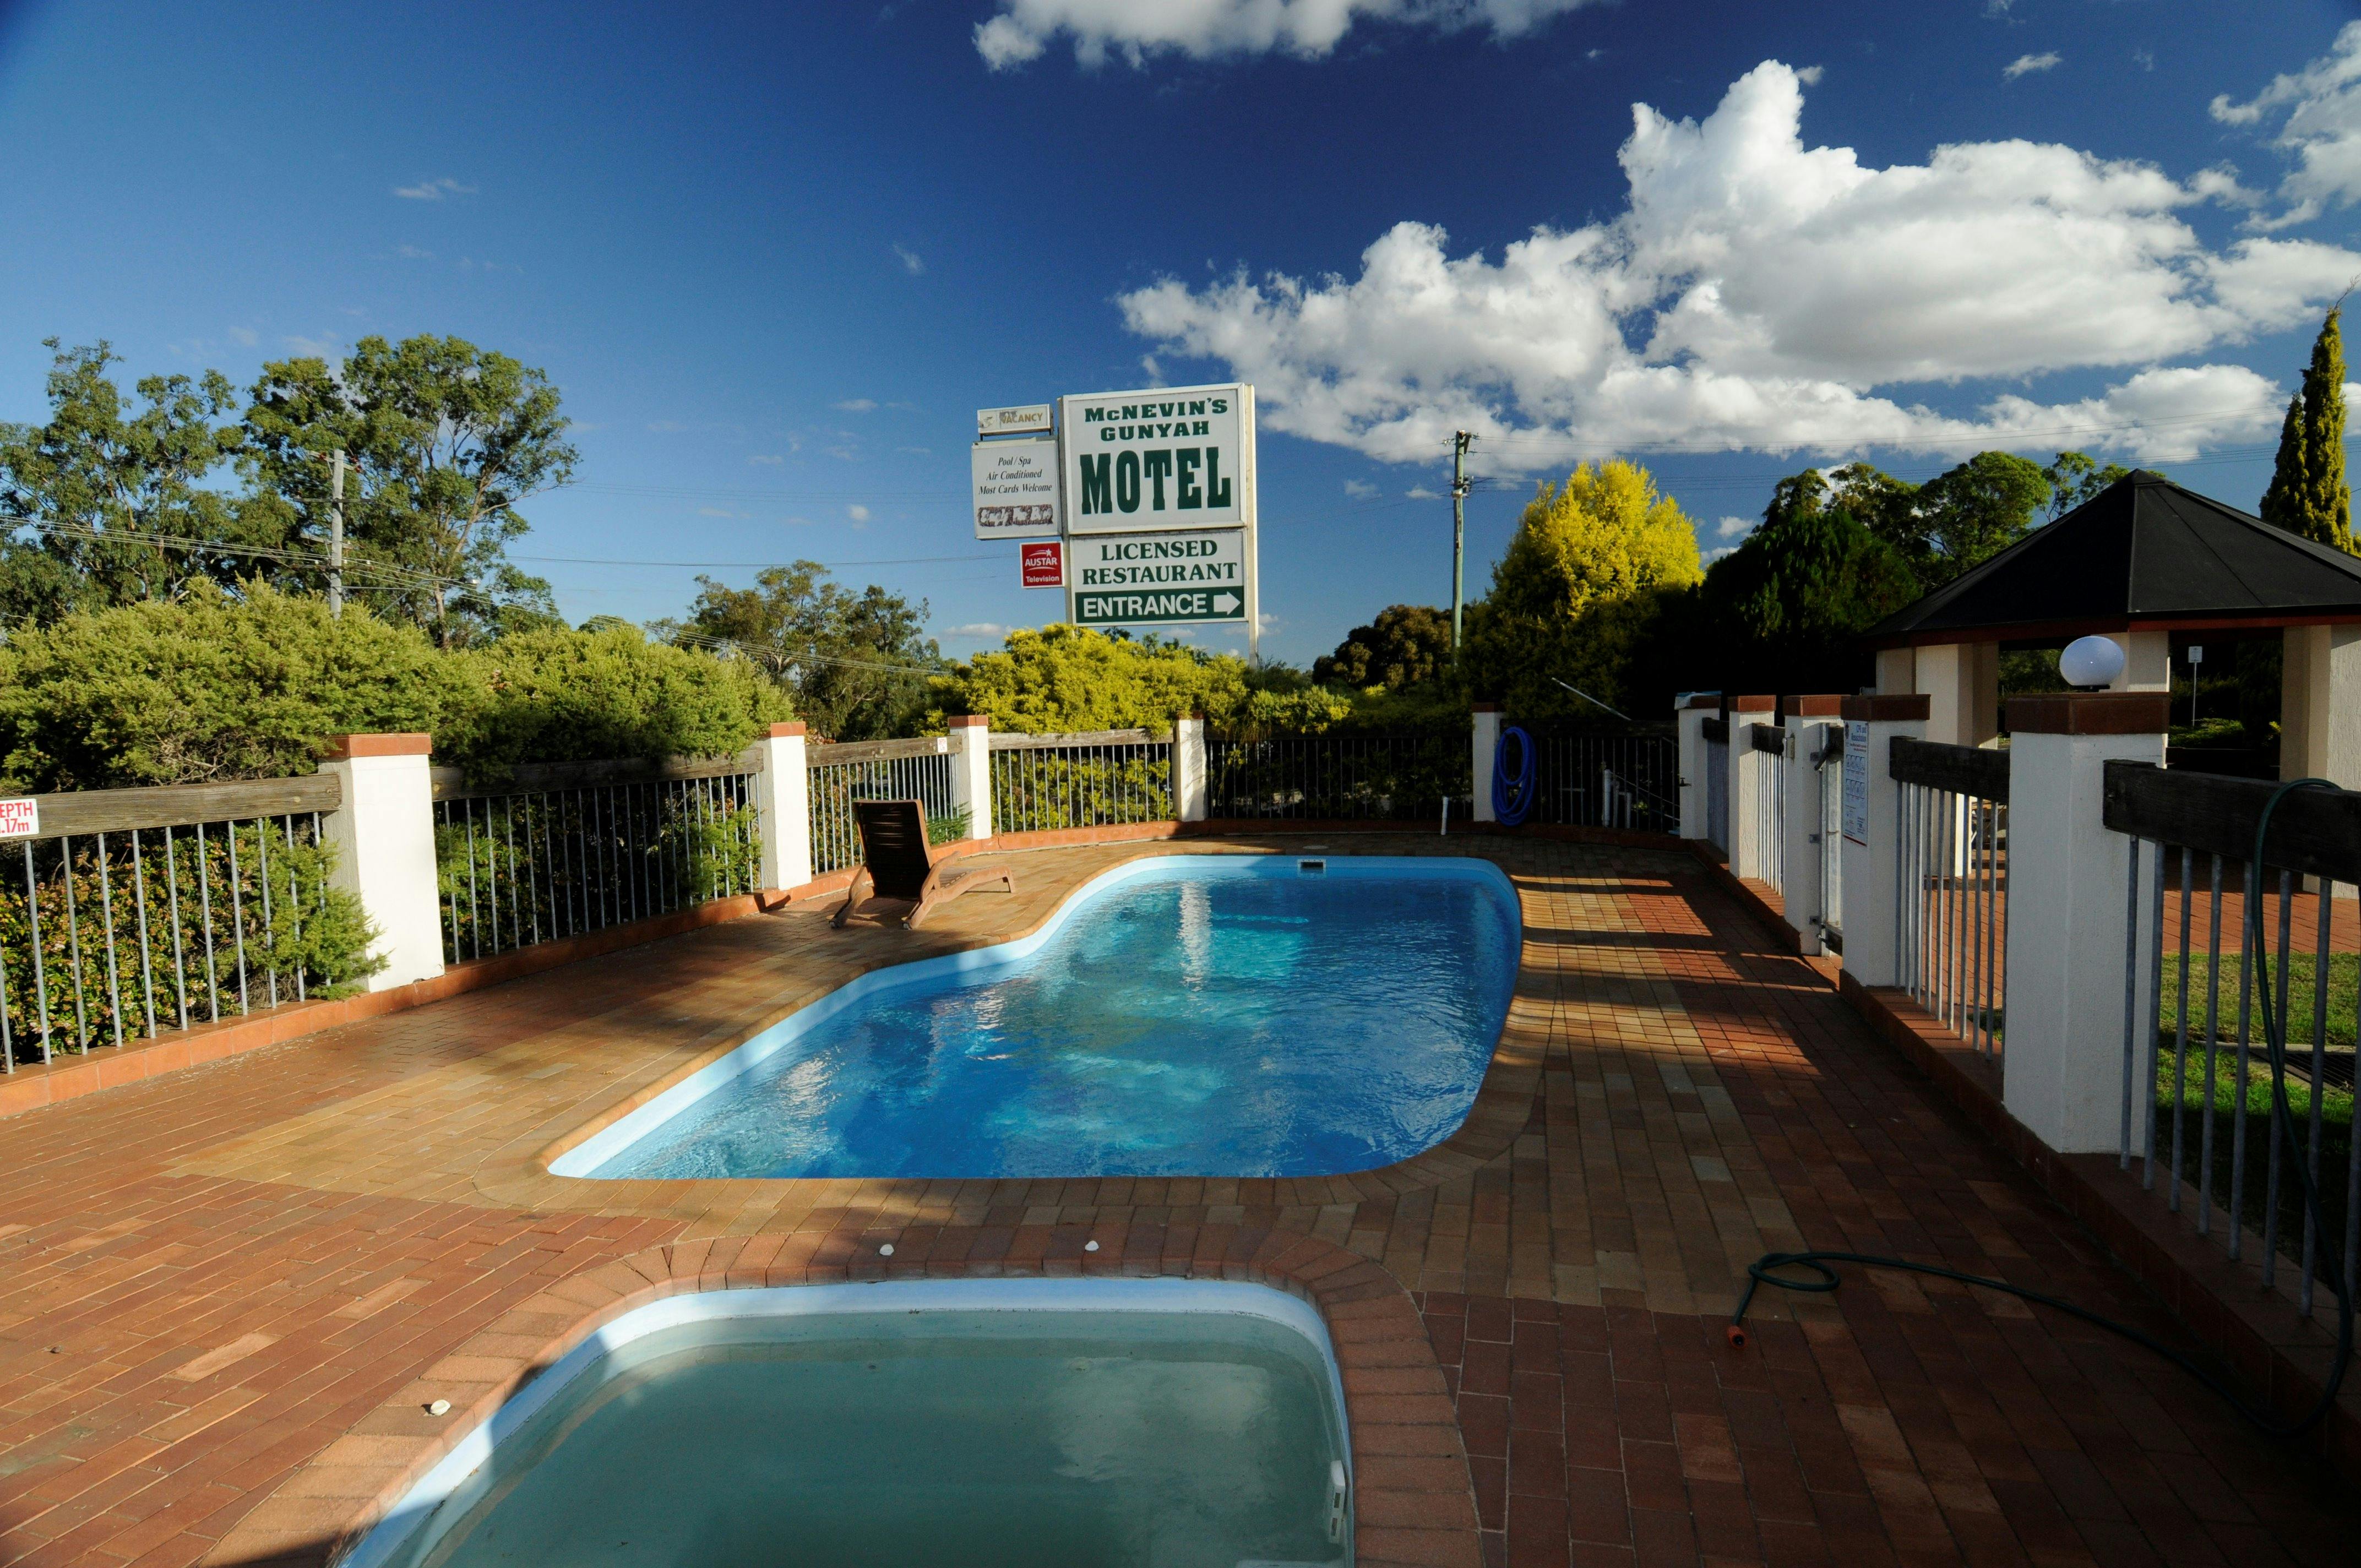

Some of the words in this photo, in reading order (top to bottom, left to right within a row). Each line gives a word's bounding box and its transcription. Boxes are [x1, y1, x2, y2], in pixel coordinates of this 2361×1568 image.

[1085, 398, 1228, 422] McNEVIN'S
[1101, 421, 1209, 442] GUNYAH
[998, 456, 1014, 466] Pool
[1018, 456, 1031, 467] Spa
[986, 472, 998, 481] Air
[1000, 469, 1042, 480] Conditioned
[1080, 447, 1231, 515] MOTEL
[978, 486, 995, 494] Most
[998, 484, 1019, 494] Cards
[1022, 483, 1052, 492] Welcome
[1101, 540, 1217, 561] LICENSED
[1025, 557, 1057, 567] AUSTAR
[1082, 562, 1237, 585] RESTAURANT
[1083, 594, 1207, 617] ENTRANCE
[0, 818, 29, 834] .17m
